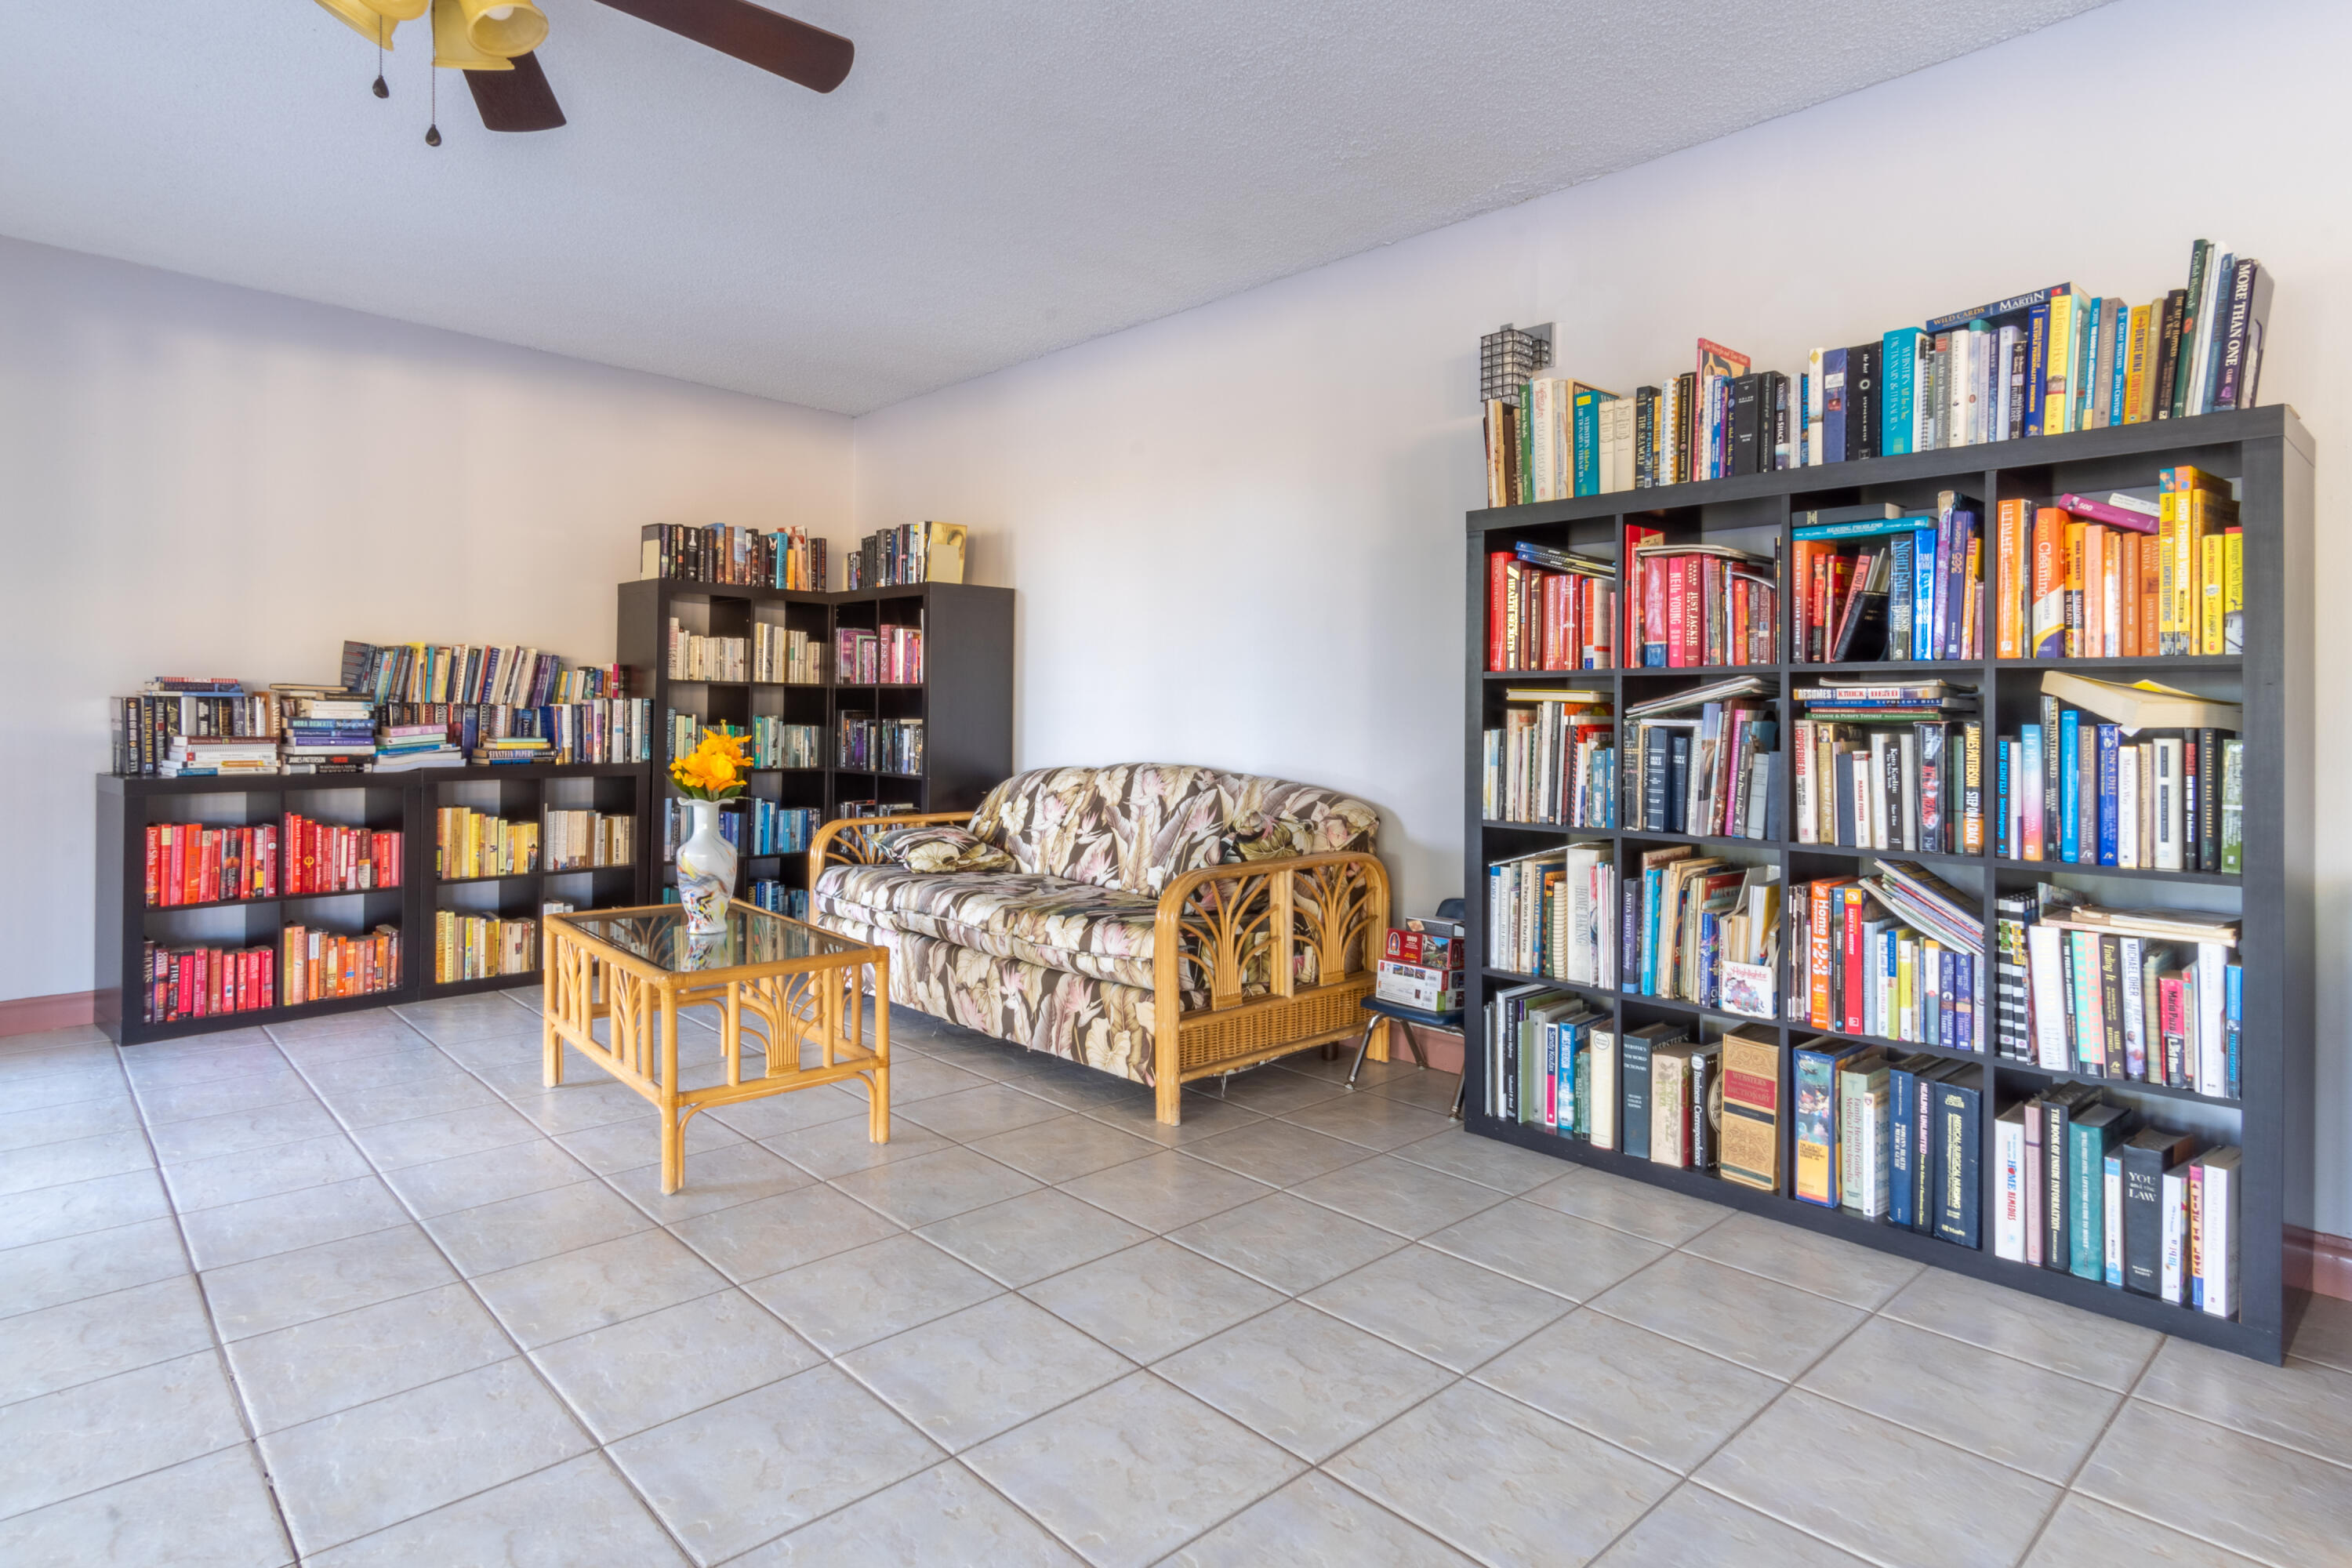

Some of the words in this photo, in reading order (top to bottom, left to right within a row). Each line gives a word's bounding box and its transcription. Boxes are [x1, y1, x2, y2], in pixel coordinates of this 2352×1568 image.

[1999, 289, 2045, 312] MARTIN
[1933, 314, 1956, 326] WILD
[1957, 306, 1985, 321] CARDS
[2229, 300, 2247, 338] THAN
[2117, 322, 2126, 342] GREAT
[2133, 328, 2147, 353] DENISE
[1889, 336, 1900, 381] DICTIONARY
[2116, 343, 2125, 370] SPEECHES
[2132, 353, 2142, 373] MINA
[2225, 339, 2241, 367] ONE
[1777, 382, 1787, 405] YOUNG
[1889, 382, 1900, 390] &
[2128, 374, 2141, 416] CONVICTION
[1889, 390, 1900, 431] THESAURUS
[2112, 390, 2122, 417] CENTURY
[1637, 416, 1647, 430] THE
[1777, 422, 1786, 445] SHACK
[1637, 431, 1647, 445] SEA
[1637, 445, 1647, 466] WOLF
[2178, 499, 2190, 522] HOW
[2178, 525, 2190, 560] THINGS
[2230, 537, 2242, 567] Younger
[2143, 544, 2151, 572] INDIA
[1669, 572, 1682, 593] NEIL
[1853, 572, 1865, 586] YOU
[2178, 561, 2190, 591] WORK
[2230, 568, 2242, 583] Next
[1507, 578, 1518, 612] HEALTH
[1690, 592, 1699, 612] JUST
[2065, 595, 2074, 604] IN
[2230, 583, 2242, 598] Year
[1669, 595, 1682, 625] YOUNG
[1901, 604, 1911, 632] NELSON
[2065, 604, 2074, 626] DEATH
[2074, 594, 2084, 626] MEMORY
[2146, 598, 2154, 621] JAVIER
[1507, 612, 1518, 652] SECRETS
[1690, 614, 1699, 647] JACKIE
[2146, 622, 2154, 644] MORO
[1965, 727, 1980, 749] JAMES
[2205, 732, 2213, 744] THE
[1796, 728, 1806, 775] COPPERHEAD
[1998, 740, 2009, 761] JERRY
[2107, 750, 2118, 764] ON
[1922, 765, 1936, 781] ACT
[1965, 748, 1980, 787] PATTERSON
[1998, 761, 2009, 795] SEINFELD
[1823, 786, 1833, 800] Best
[2107, 775, 2118, 796] DIET
[2205, 784, 2213, 800] MALE
[1823, 800, 1833, 815] Life
[1965, 791, 1980, 807] STEP
[2205, 804, 2213, 838] SYNDROME
[147, 829, 158, 851] Daniel
[1965, 822, 1980, 845] CRACK
[147, 850, 158, 866] Silva
[1521, 872, 1530, 885] How
[1521, 886, 1530, 903] Things
[1624, 891, 1633, 913] ANITA
[1521, 903, 1530, 918] Work
[1818, 899, 1831, 936] Home
[1521, 924, 1530, 936] Your
[1624, 914, 1633, 938] SHREVE
[1521, 936, 1530, 953] Home
[1624, 942, 1633, 971] Testimony
[1812, 936, 1829, 977] 1-2-3
[2074, 935, 2086, 1001] PRIVATE
[2102, 943, 2115, 973] Finding
[2125, 943, 2138, 974] MICHAEL
[169, 964, 180, 985] FIRE
[2087, 935, 2099, 1003] HOWARD
[2104, 974, 2117, 982] It
[2128, 975, 2140, 996] OHER
[2167, 990, 2180, 1011] Mario
[1947, 1010, 1955, 1040] CHARLAINE
[2167, 1011, 2180, 1031] Puzo
[1547, 1029, 1556, 1050] Sandy
[1561, 1029, 1571, 1044] JAMES
[2078, 1010, 2090, 1058] PARTS
[2092, 1011, 2103, 1061] STERN
[2106, 1026, 2114, 1053] BERTINELLI
[1547, 1051, 1556, 1073] Koufax
[1561, 1043, 1571, 1069] PATTERSON
[1693, 1070, 1703, 1105] Business
[1919, 1082, 1929, 1114] HEALING
[1845, 1097, 1854, 1129] Medical
[2050, 1108, 2061, 1124] THE
[1693, 1105, 1705, 1167] Correspondence
[1919, 1114, 1929, 1156] UNLIMITED
[2050, 1123, 2061, 1145] BOOK
[1845, 1129, 1854, 1183] Encyclopedia
[2050, 1144, 2061, 1155] OF
[2050, 1154, 2061, 1179] INSIDE
[2129, 1171, 2157, 1185] YOU
[2007, 1191, 2018, 1221] REMEDIES
[2050, 1179, 2061, 1232] INFORMATION
[2128, 1188, 2157, 1203] LAW
